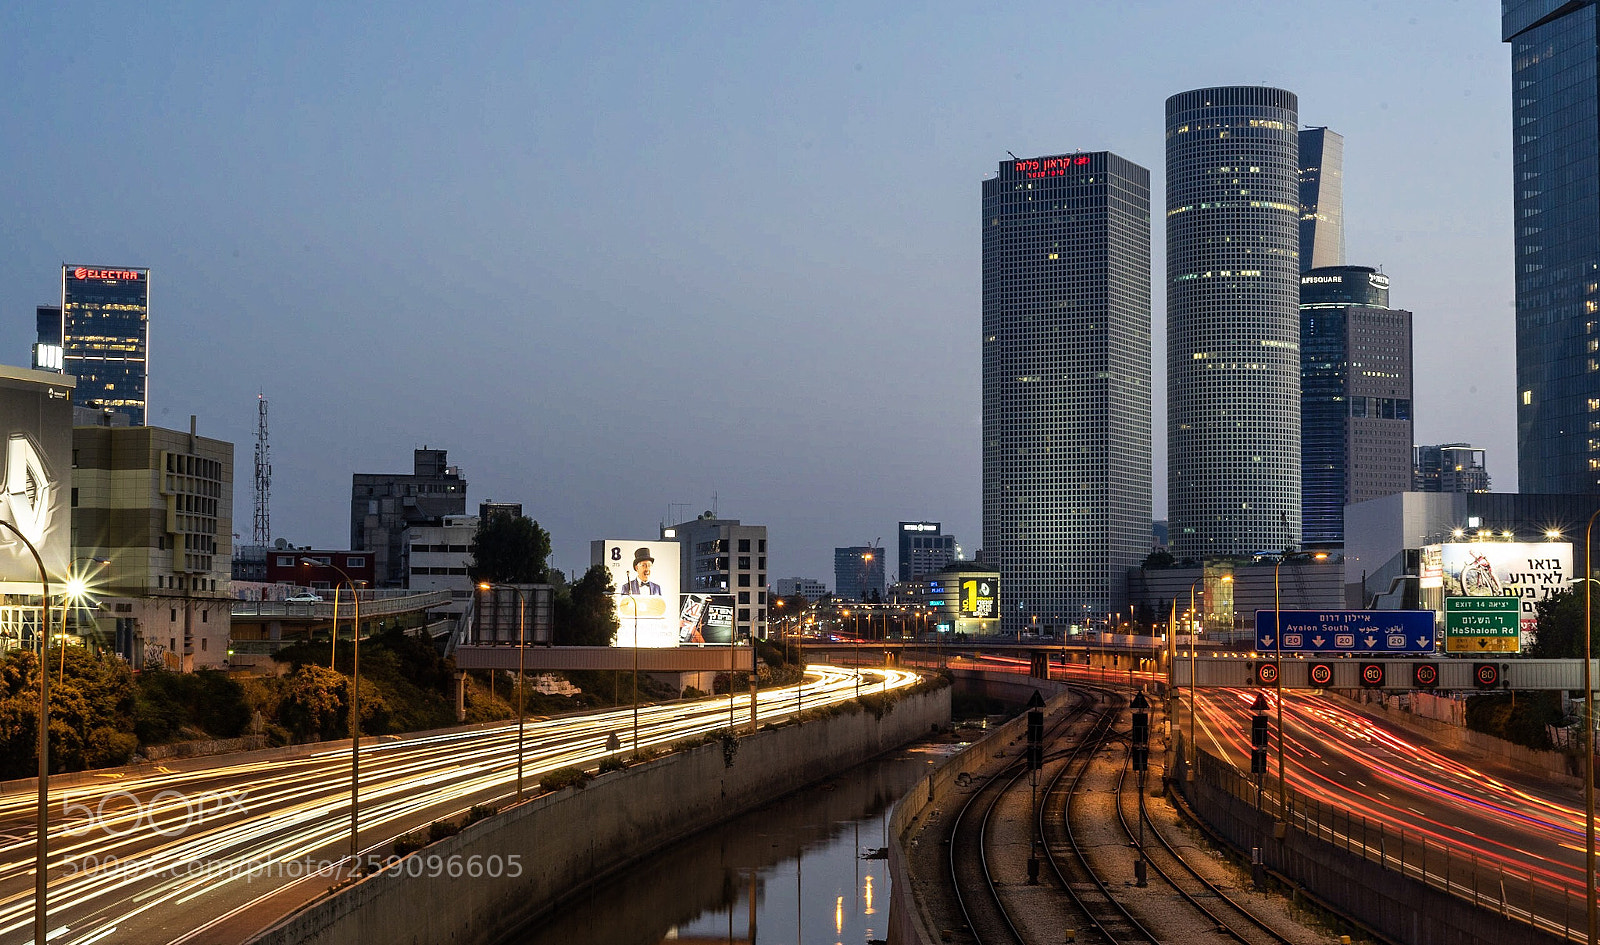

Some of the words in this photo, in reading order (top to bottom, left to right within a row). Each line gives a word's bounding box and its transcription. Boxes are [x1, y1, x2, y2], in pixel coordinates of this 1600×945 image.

[1015, 160, 1039, 171] פלזה
[1043, 157, 1071, 170] קראון
[87, 269, 138, 280] ELECTRA
[1313, 276, 1343, 284] SQUARE
[1528, 559, 1562, 569] בואו
[1509, 571, 1562, 584] לאירוע
[963, 580, 977, 612] 1
[1319, 614, 1340, 622] דרום
[1344, 614, 1371, 622] איילון
[1462, 616, 1490, 624] השלום
[1286, 624, 1317, 632] Ayalon
[1263, 669, 1275, 678] 80
[1315, 670, 1327, 678] 80
[1367, 670, 1379, 678] 80
[1420, 670, 1432, 679] 80
[1481, 670, 1493, 679] 80
